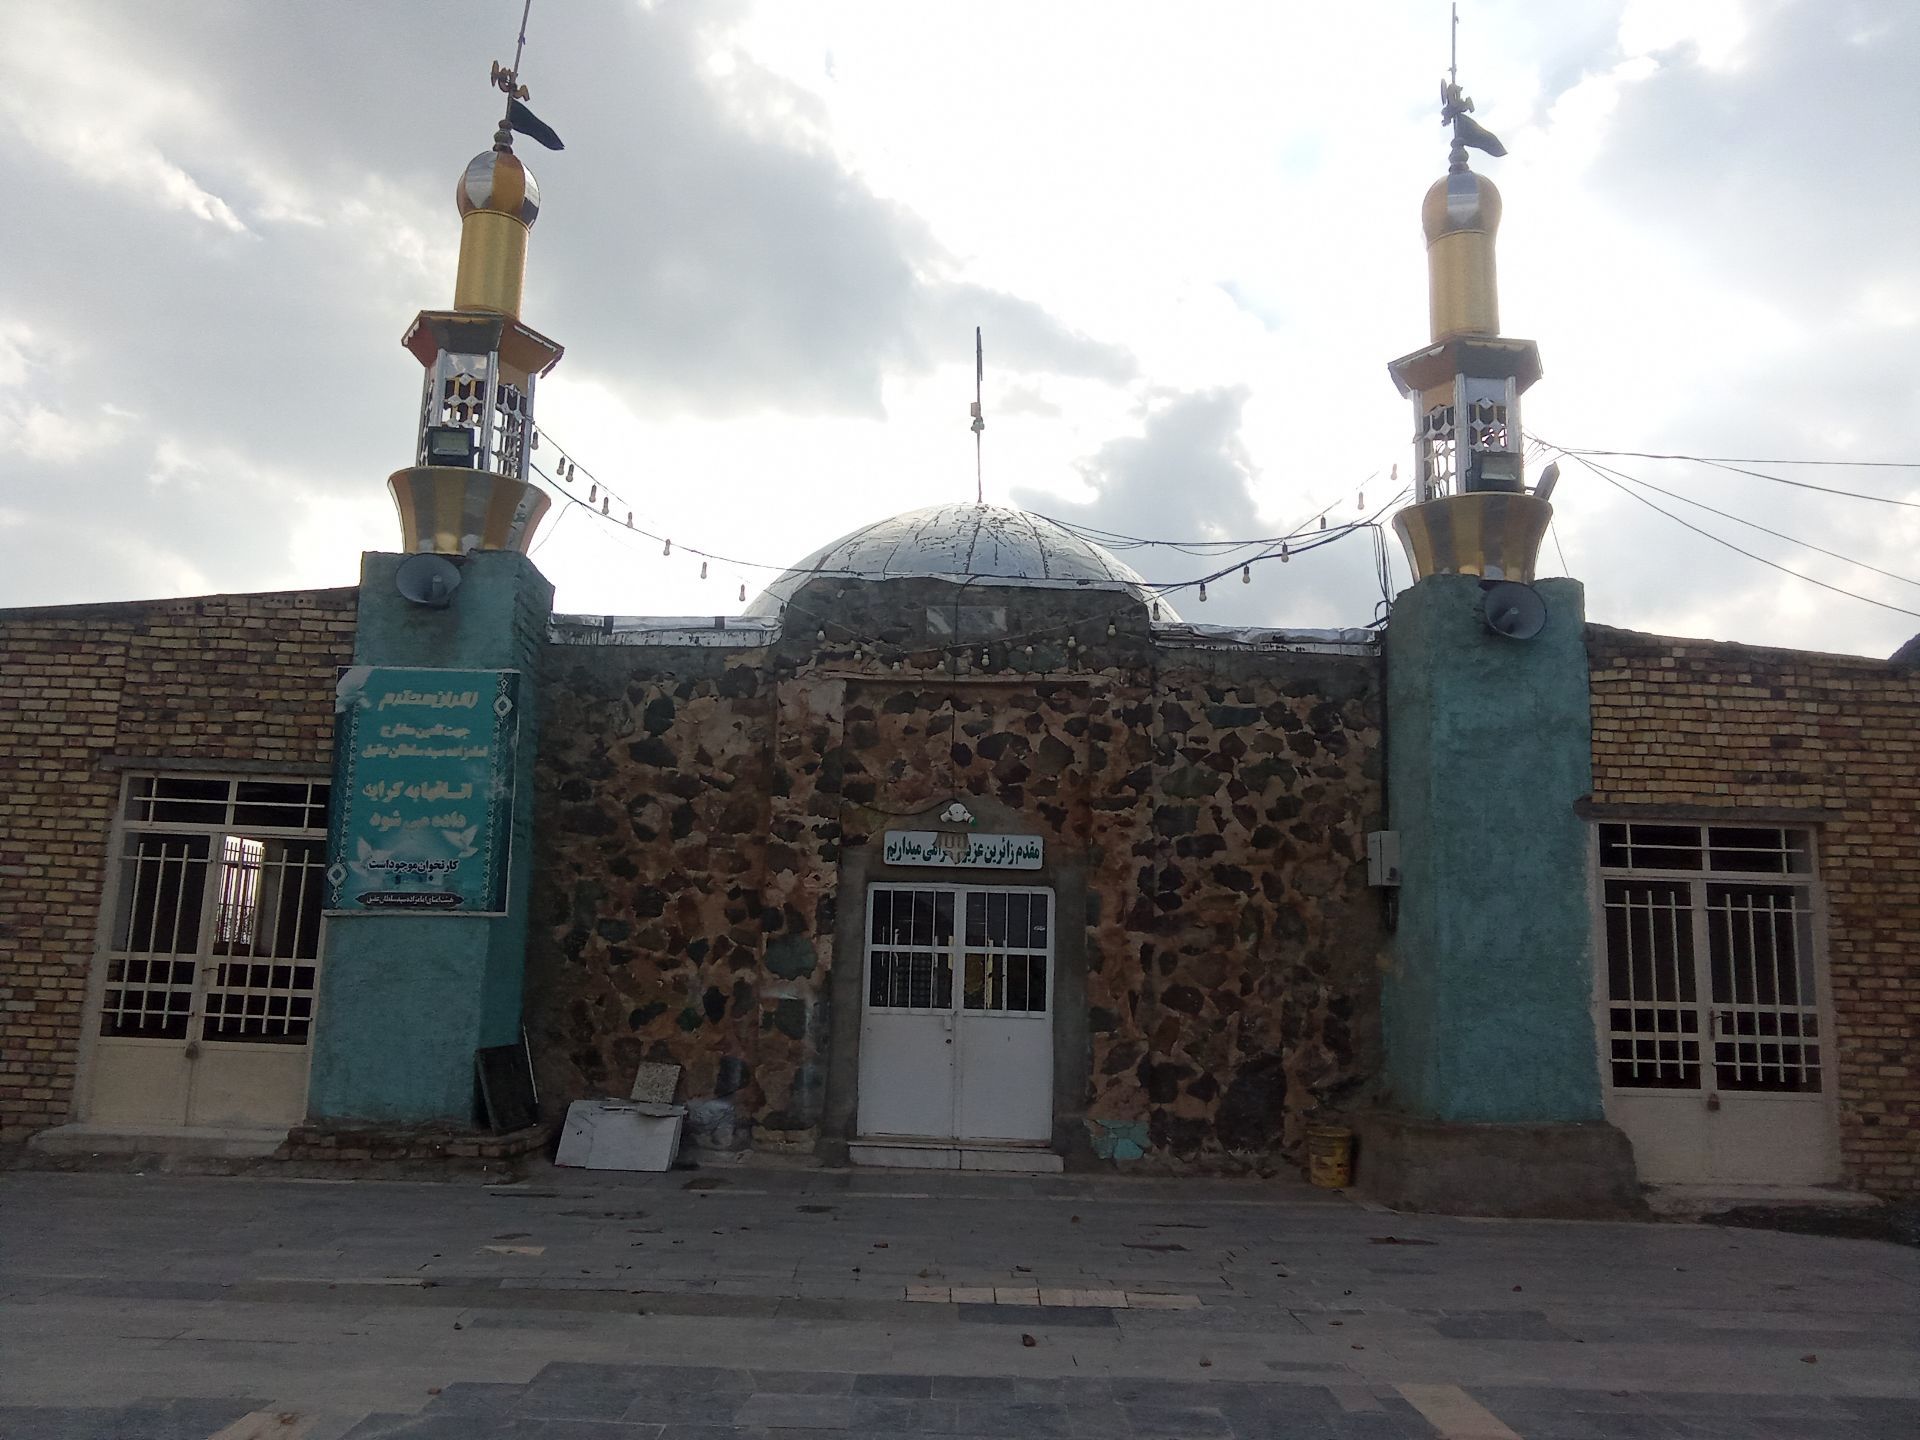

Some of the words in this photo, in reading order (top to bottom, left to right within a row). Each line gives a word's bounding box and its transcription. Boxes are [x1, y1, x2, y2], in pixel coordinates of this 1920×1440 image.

[369, 810, 401, 832] شود
[431, 811, 467, 828] داده
[984, 836, 1015, 865] زائرین
[1016, 840, 1040, 865] مقدم
[368, 859, 390, 869] است
[390, 860, 418, 873] موجود
